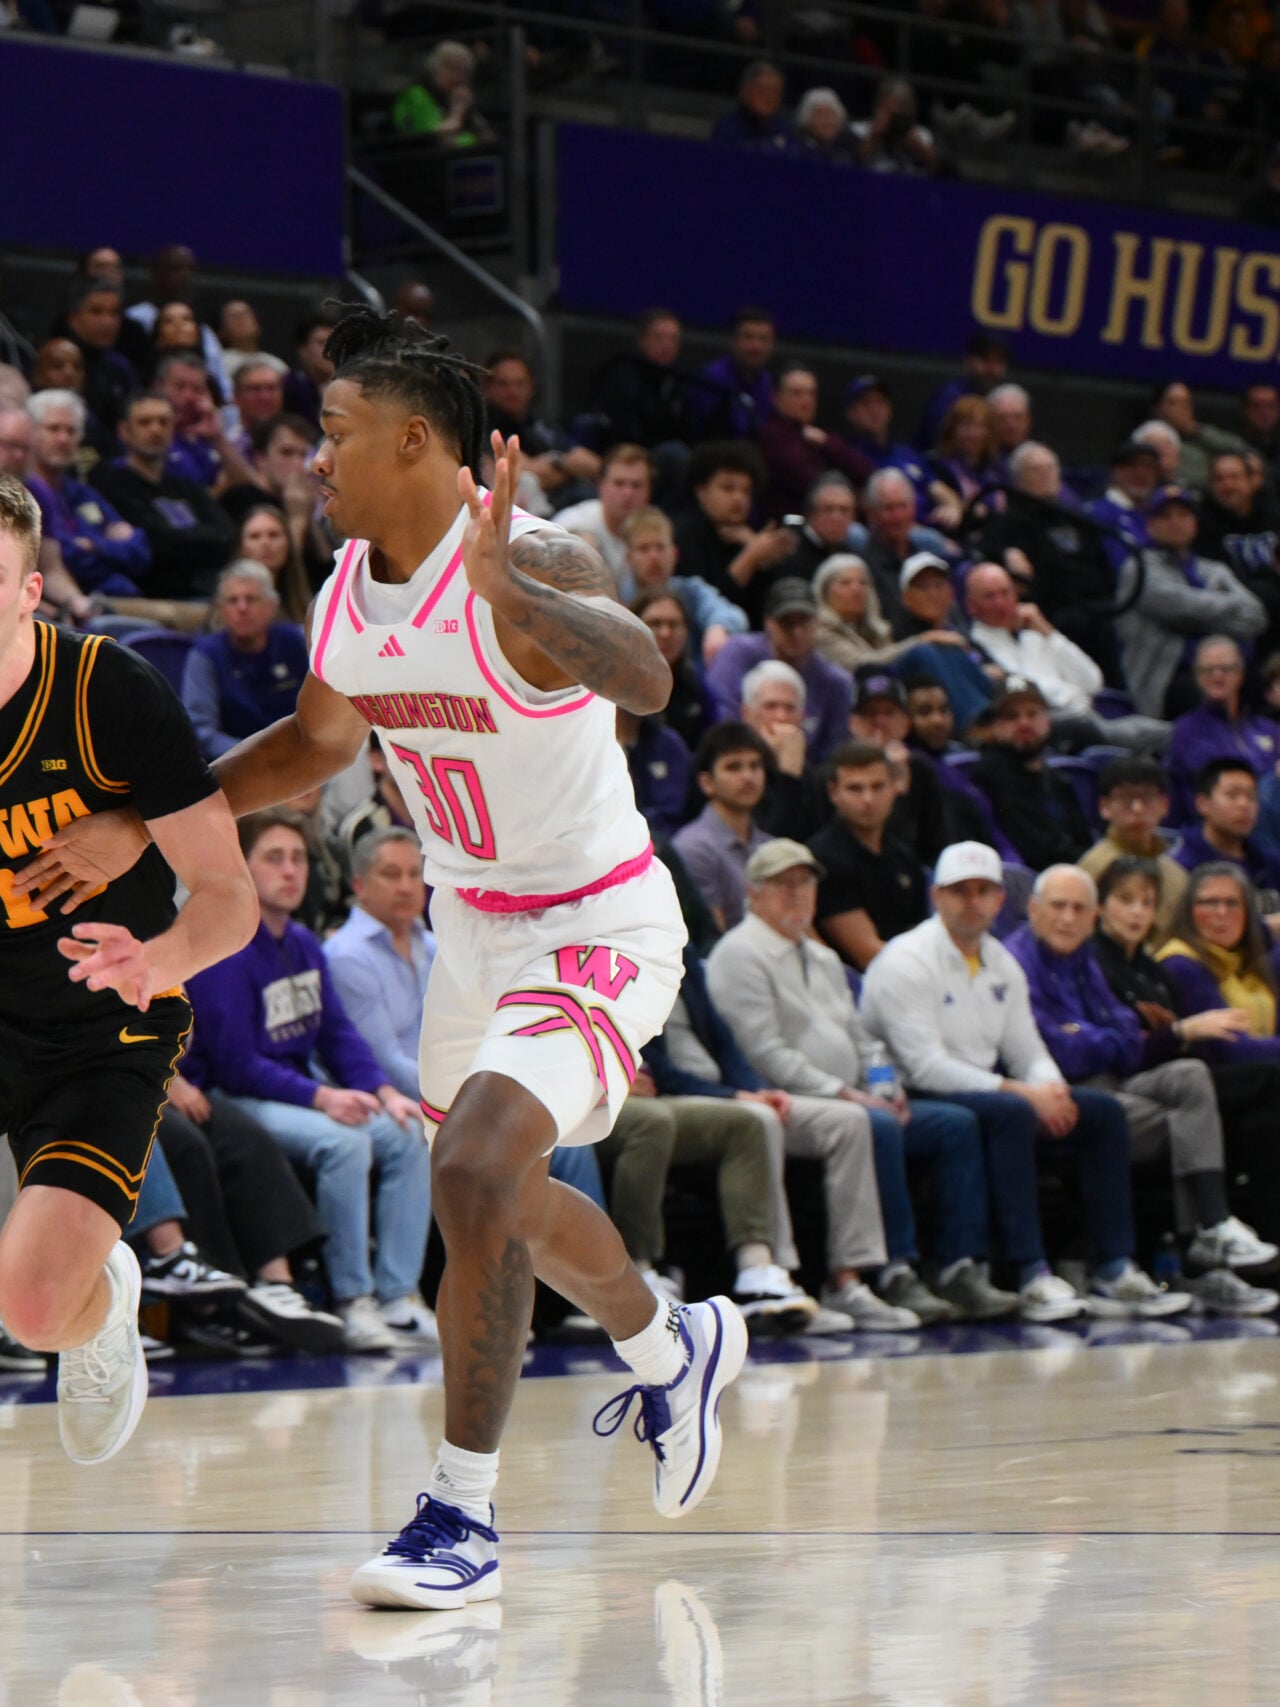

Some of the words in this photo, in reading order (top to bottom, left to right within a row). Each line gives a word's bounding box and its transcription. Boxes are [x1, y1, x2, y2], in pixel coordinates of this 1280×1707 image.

[971, 214, 1091, 337] GO
[388, 741, 499, 863] 30
[554, 944, 640, 1001] W
